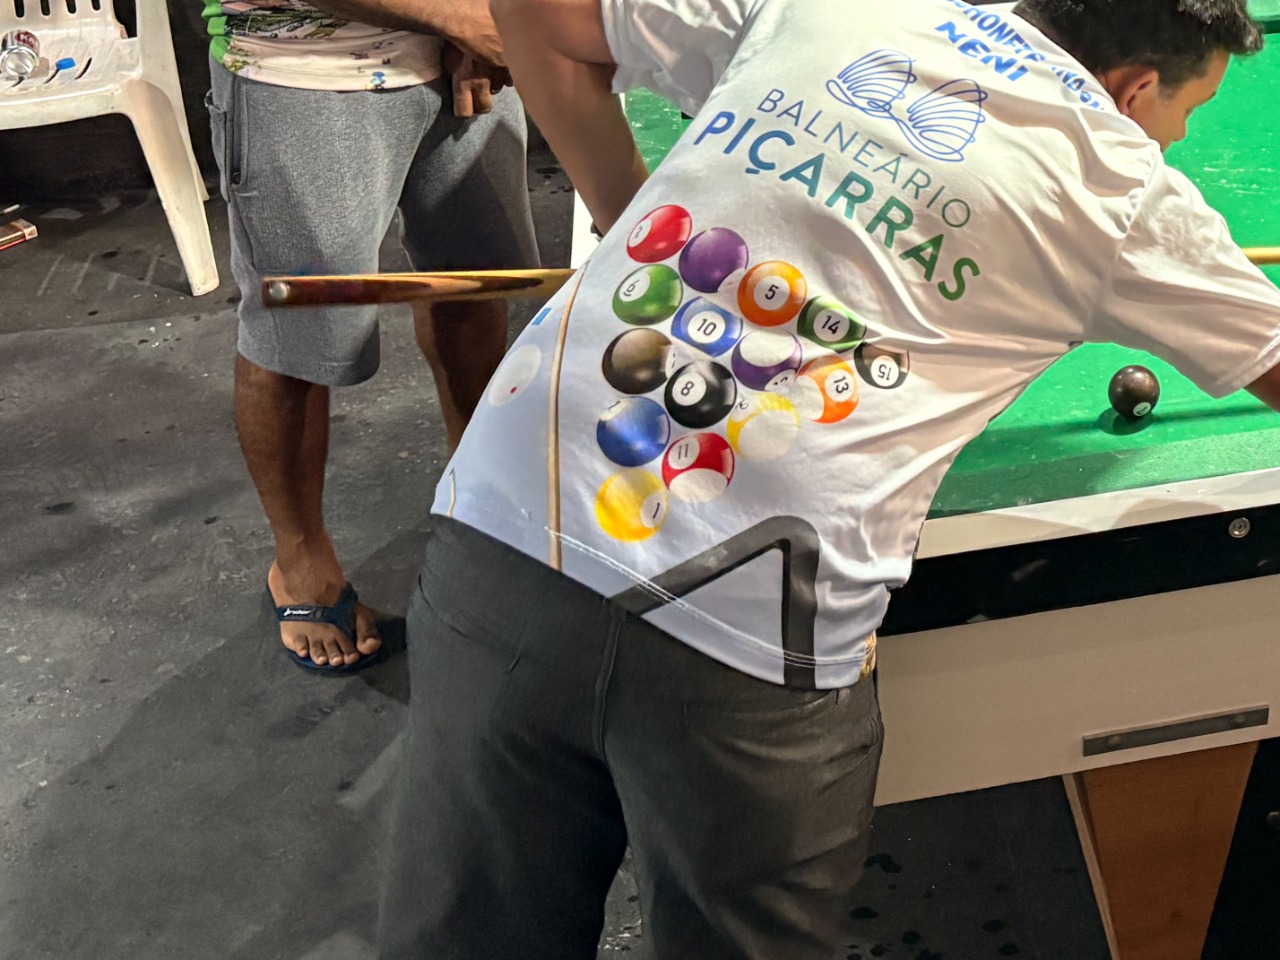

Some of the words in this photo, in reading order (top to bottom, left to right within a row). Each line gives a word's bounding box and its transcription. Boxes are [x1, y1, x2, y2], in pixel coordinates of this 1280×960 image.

[934, 21, 1029, 81] NENI
[757, 88, 972, 228] BALNEÁRIO
[693, 111, 980, 301] PIÇARRAS
[765, 285, 780, 301] 5
[698, 318, 718, 336] 10
[822, 315, 842, 334] 14
[877, 363, 893, 380] 15
[681, 381, 695, 396] 8
[833, 375, 850, 394] 13
[677, 443, 690, 458] 11
[652, 502, 661, 519] 1
